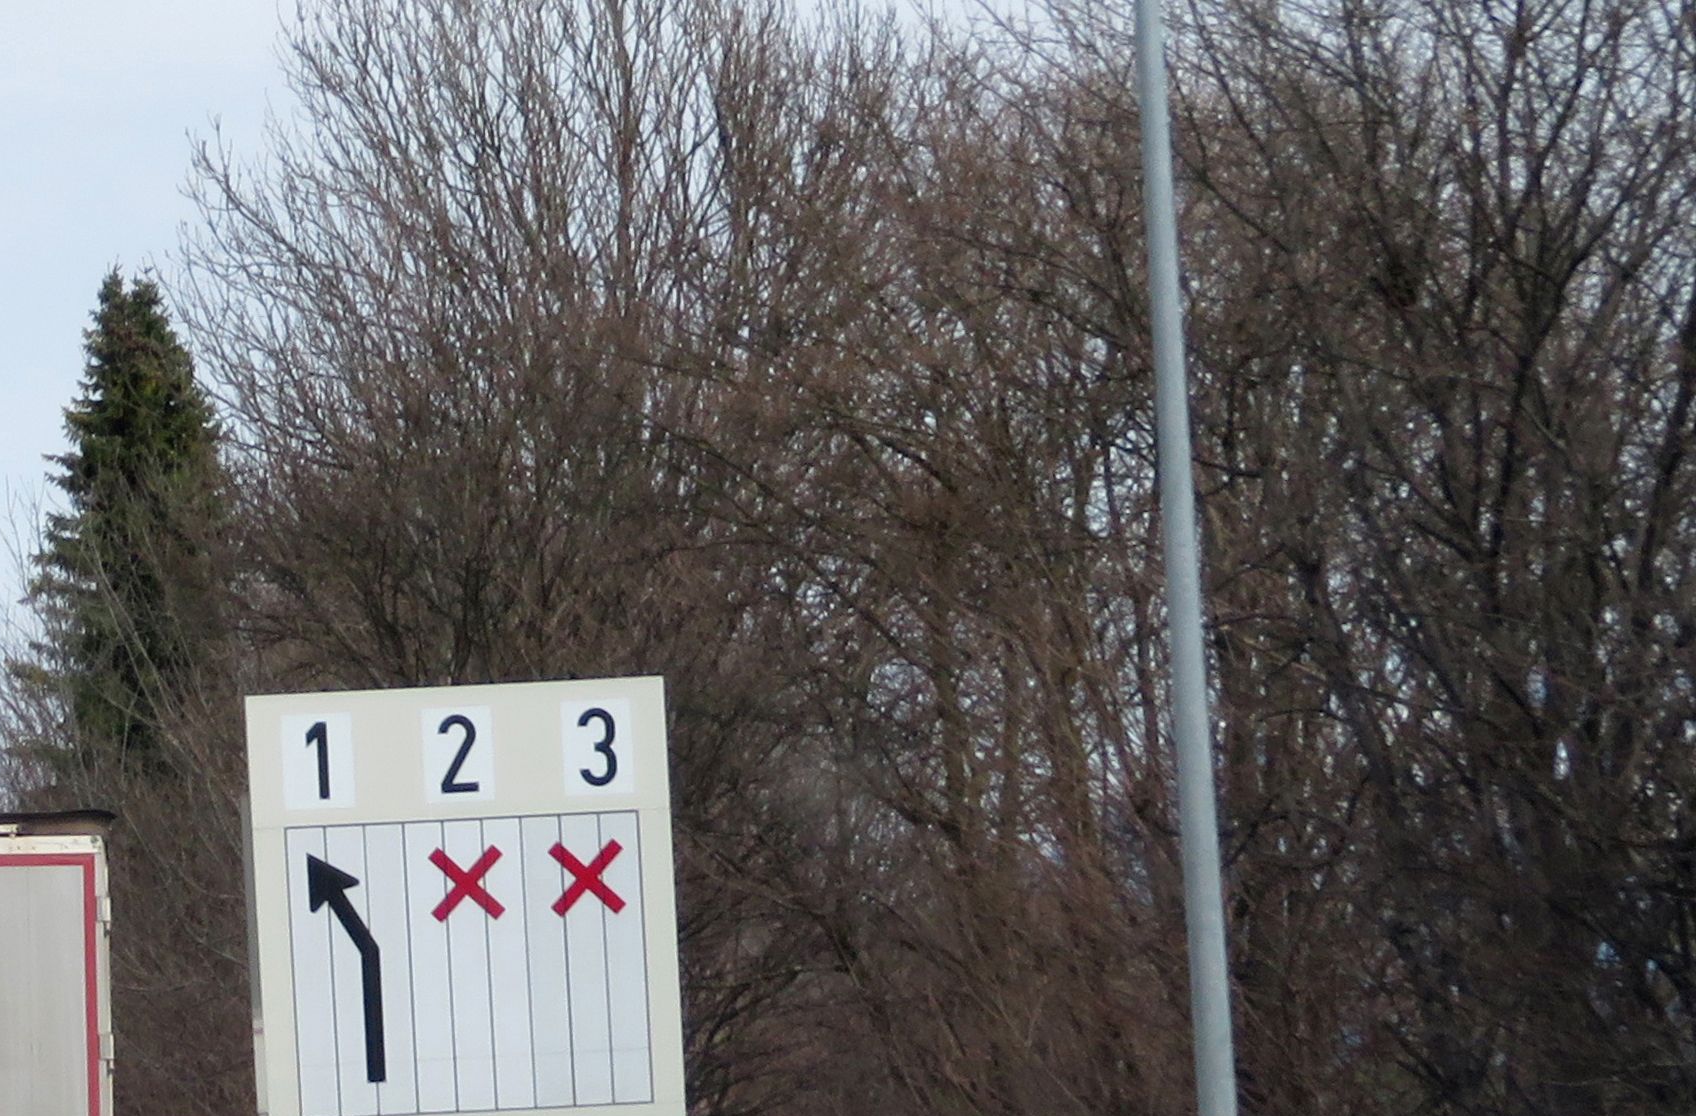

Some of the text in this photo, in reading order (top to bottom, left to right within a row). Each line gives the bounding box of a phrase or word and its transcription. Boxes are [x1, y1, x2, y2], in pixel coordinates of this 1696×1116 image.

[304, 707, 619, 800] 1 2 3
